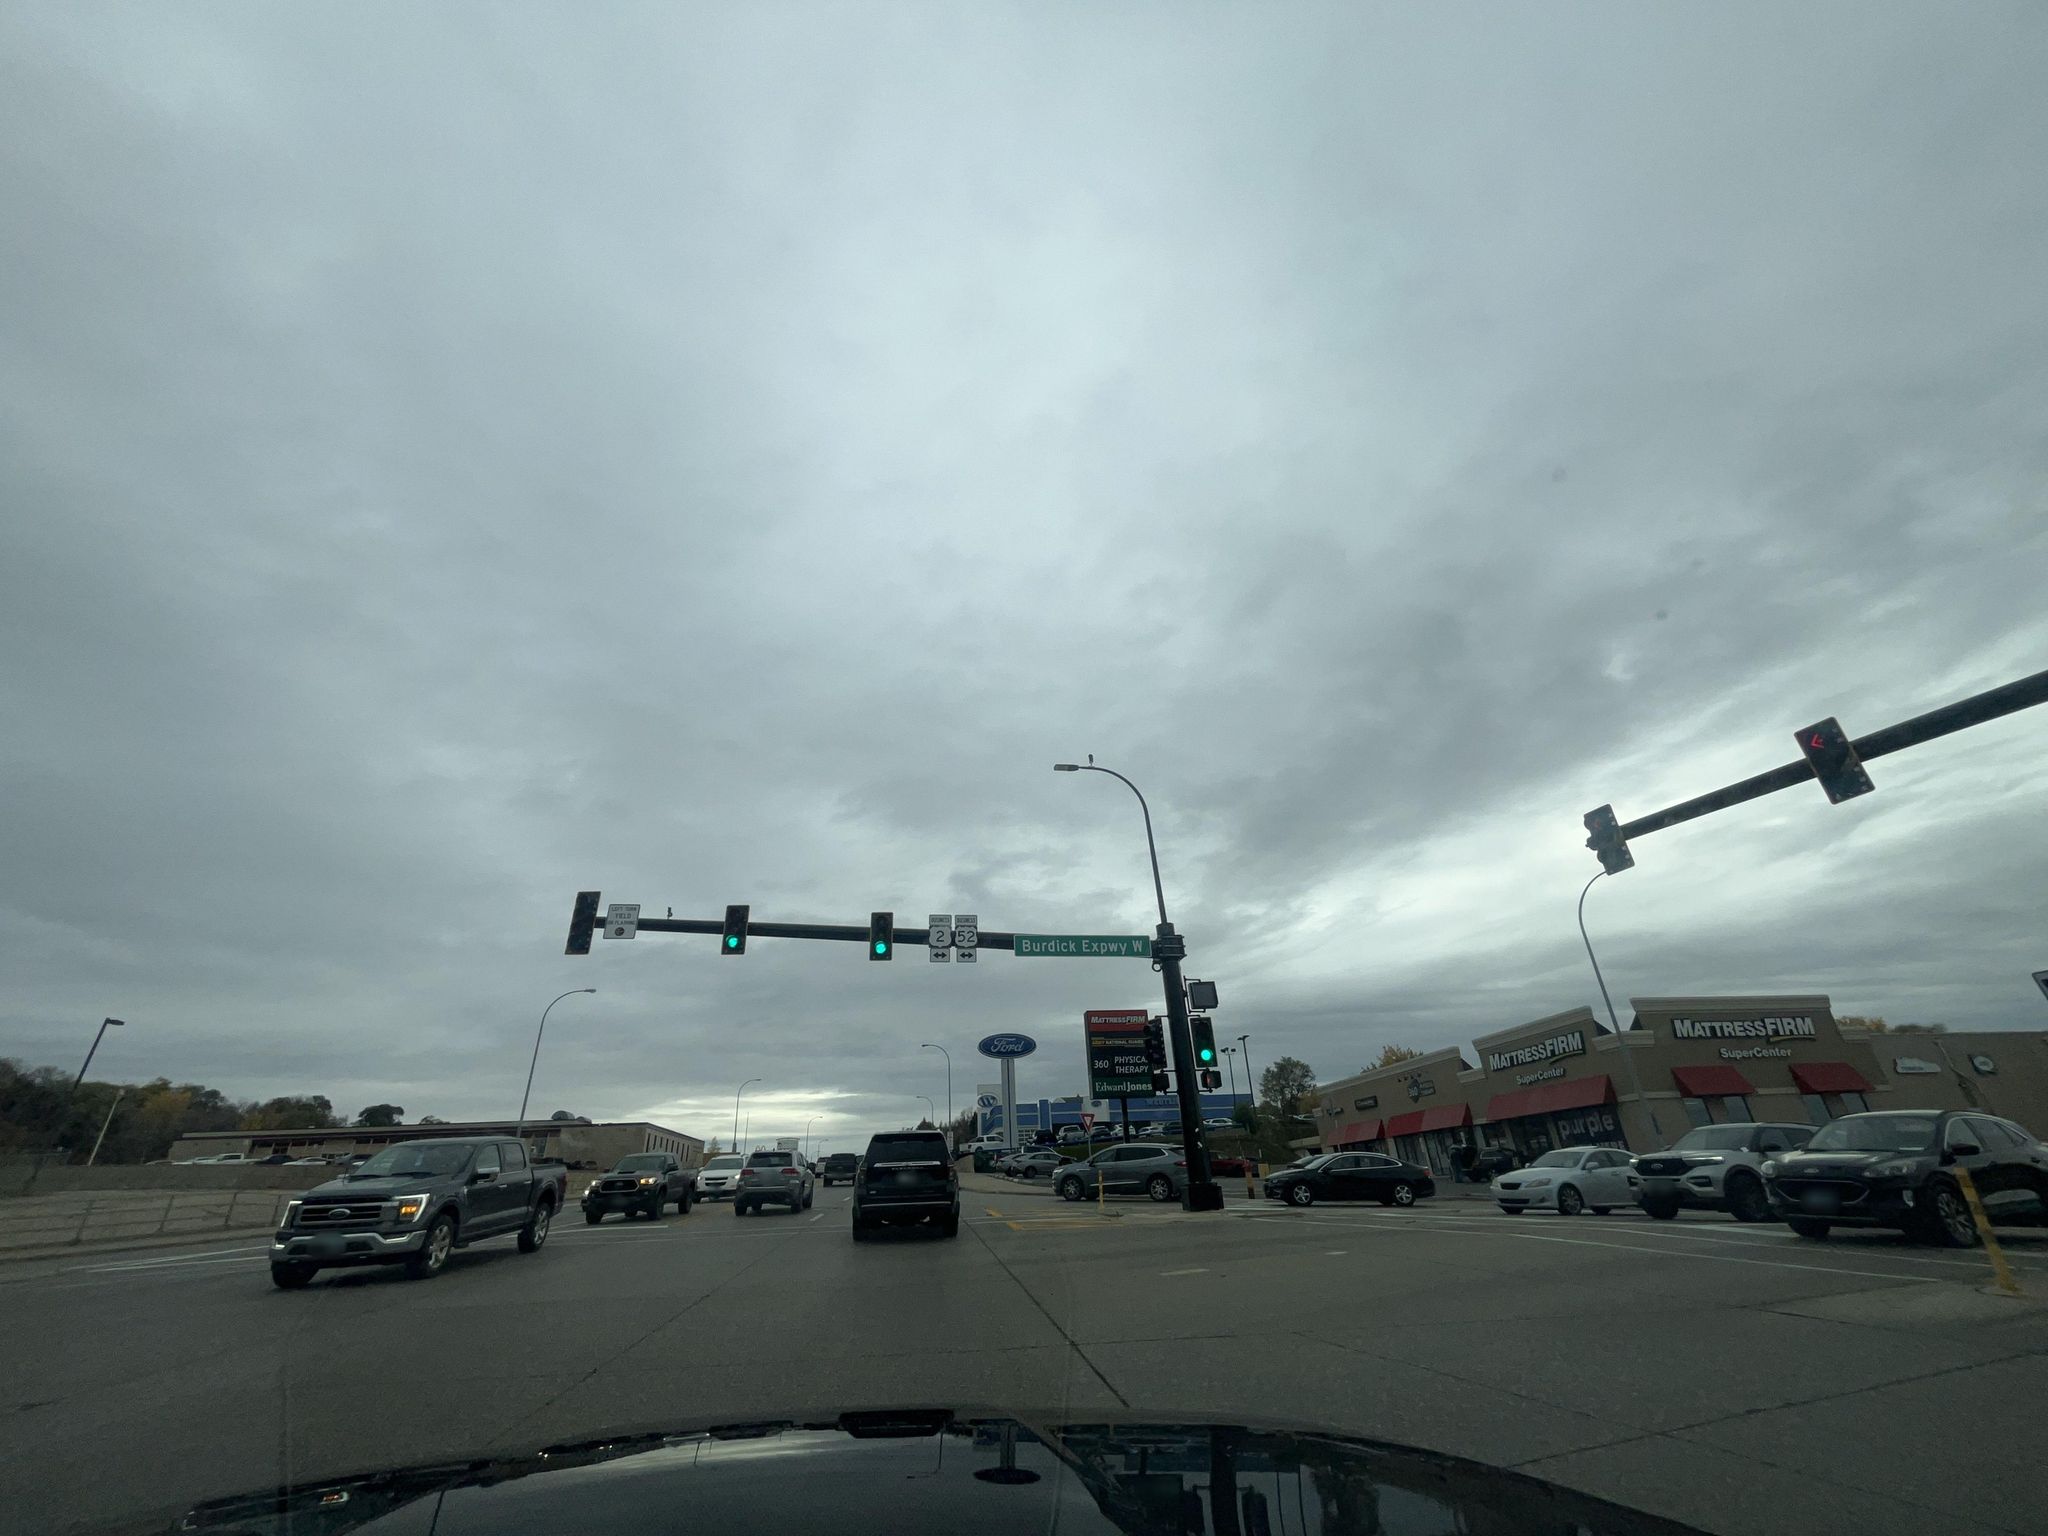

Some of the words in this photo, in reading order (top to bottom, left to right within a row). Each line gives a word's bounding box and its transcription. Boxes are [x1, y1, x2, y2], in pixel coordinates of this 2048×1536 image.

[936, 930, 945, 943] 2
[957, 930, 976, 943] 52
[1022, 939, 1077, 952] Burdick
[1082, 939, 1127, 954] Expwy
[1133, 940, 1143, 952] W
[1673, 1016, 1816, 1038] MATTRESSFIRM
[990, 1037, 1025, 1053] Ford
[1488, 1031, 1583, 1071] MATTRESSFIRM
[1719, 1047, 1792, 1060] SuperCenter
[1094, 1059, 1109, 1069] 360
[1115, 1065, 1149, 1074] THERAPY
[1516, 1066, 1565, 1086] SuperCenter
[1558, 1112, 1616, 1140] purple
